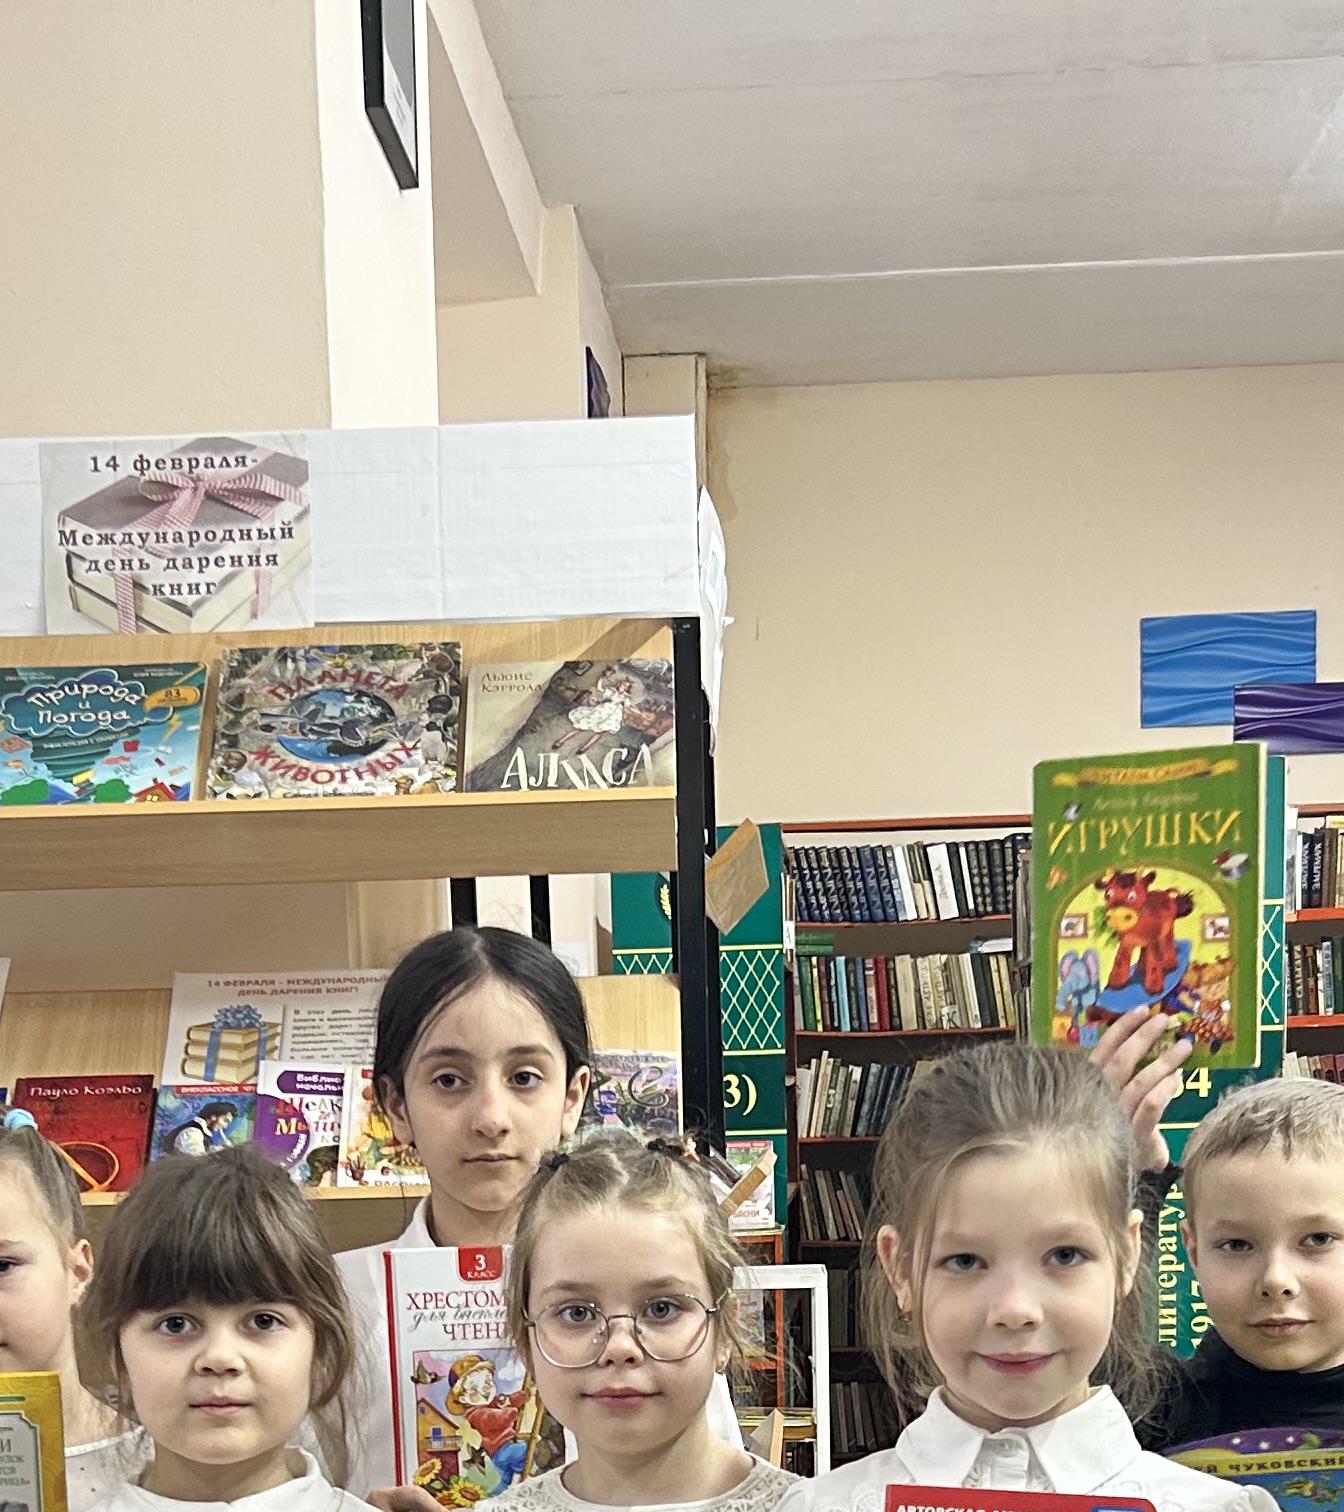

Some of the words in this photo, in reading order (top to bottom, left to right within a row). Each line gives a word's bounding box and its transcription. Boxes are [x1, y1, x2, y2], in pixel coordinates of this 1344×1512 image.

[90, 456, 120, 472] 14
[58, 521, 294, 549] Международный
[85, 558, 151, 574] день
[151, 580, 218, 597] книг
[27, 683, 144, 707] Природа
[267, 668, 410, 703] ПЛАНЕТА
[38, 709, 131, 726] Погода
[249, 741, 420, 785] ЖИВОТНЫХ
[501, 742, 654, 791] АЛИСА
[1048, 809, 1243, 856] ИГРУШКИ
[223, 979, 275, 987] ФЕВРАЛЯ
[30, 1084, 80, 1100] Пауло
[84, 1083, 143, 1097] Коэльо
[723, 1073, 757, 1116] 3)
[475, 1254, 487, 1271] 3
[1158, 1183, 1186, 1348] литератур
[467, 1270, 497, 1279] КЛАСС
[406, 1290, 507, 1310] ХРЕСТОМ
[442, 1322, 506, 1341] ЧТЕН
